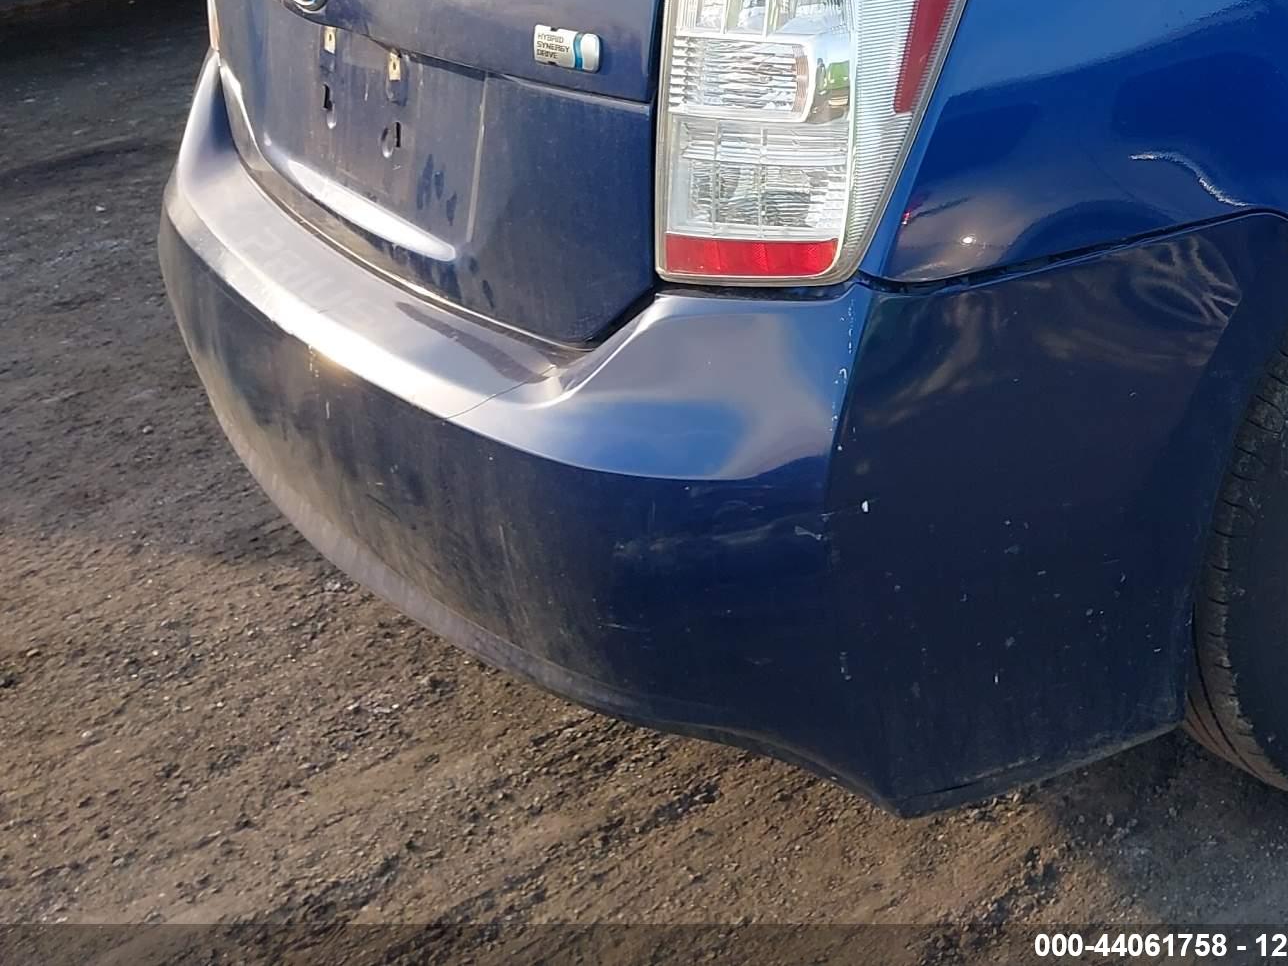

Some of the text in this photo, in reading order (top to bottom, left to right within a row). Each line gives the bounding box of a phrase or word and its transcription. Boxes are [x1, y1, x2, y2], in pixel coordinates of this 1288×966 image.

[537, 33, 564, 44] HYBRID
[536, 40, 570, 53] SYNERGY
[536, 48, 558, 59] DRIVE
